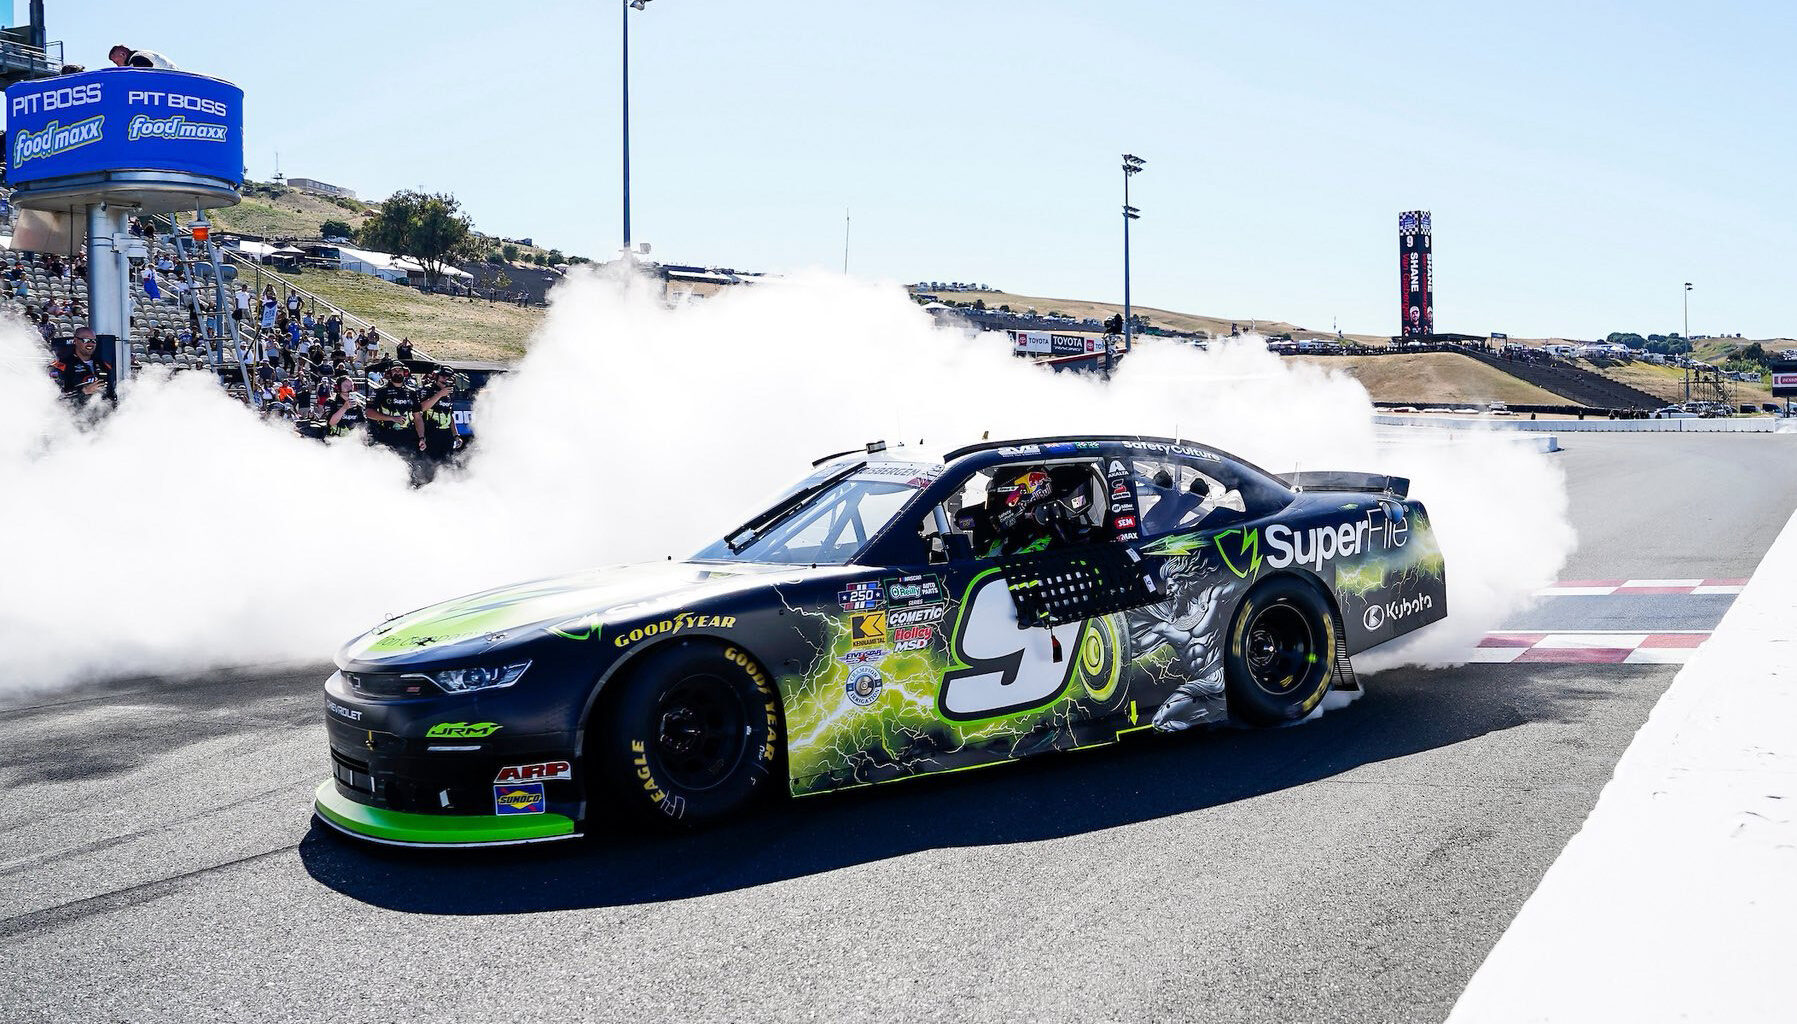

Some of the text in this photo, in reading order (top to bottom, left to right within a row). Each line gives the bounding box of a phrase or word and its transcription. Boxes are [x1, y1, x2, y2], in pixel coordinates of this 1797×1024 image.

[12, 82, 102, 117] PIT BOSS
[128, 91, 227, 117] PIT BOSS
[1406, 235, 1414, 247] 9
[1410, 252, 1419, 292] SHANE
[1028, 337, 1049, 345] TOYOTA
[1053, 336, 1083, 347] TOYOTA
[1121, 440, 1221, 461] SafetyCulture
[1117, 518, 1134, 527] SEM
[1265, 508, 1408, 572] SuperFile
[849, 590, 874, 602] 250
[891, 584, 921, 599] O'Reilly
[1387, 592, 1433, 620] Kubota
[889, 606, 943, 625] COMETIC
[614, 611, 737, 648] GOODYEAR
[894, 626, 933, 642] Holley
[852, 637, 885, 647] KENNAMETAL
[894, 639, 928, 652] MSD
[944, 576, 1082, 714] 9
[724, 646, 778, 762] GOODYEAR
[849, 688, 880, 704] IRRIGATION
[431, 724, 492, 737] JRM
[498, 762, 569, 781] ARP
[631, 739, 666, 803] EAGLE
[499, 793, 541, 805] SUNOCO
